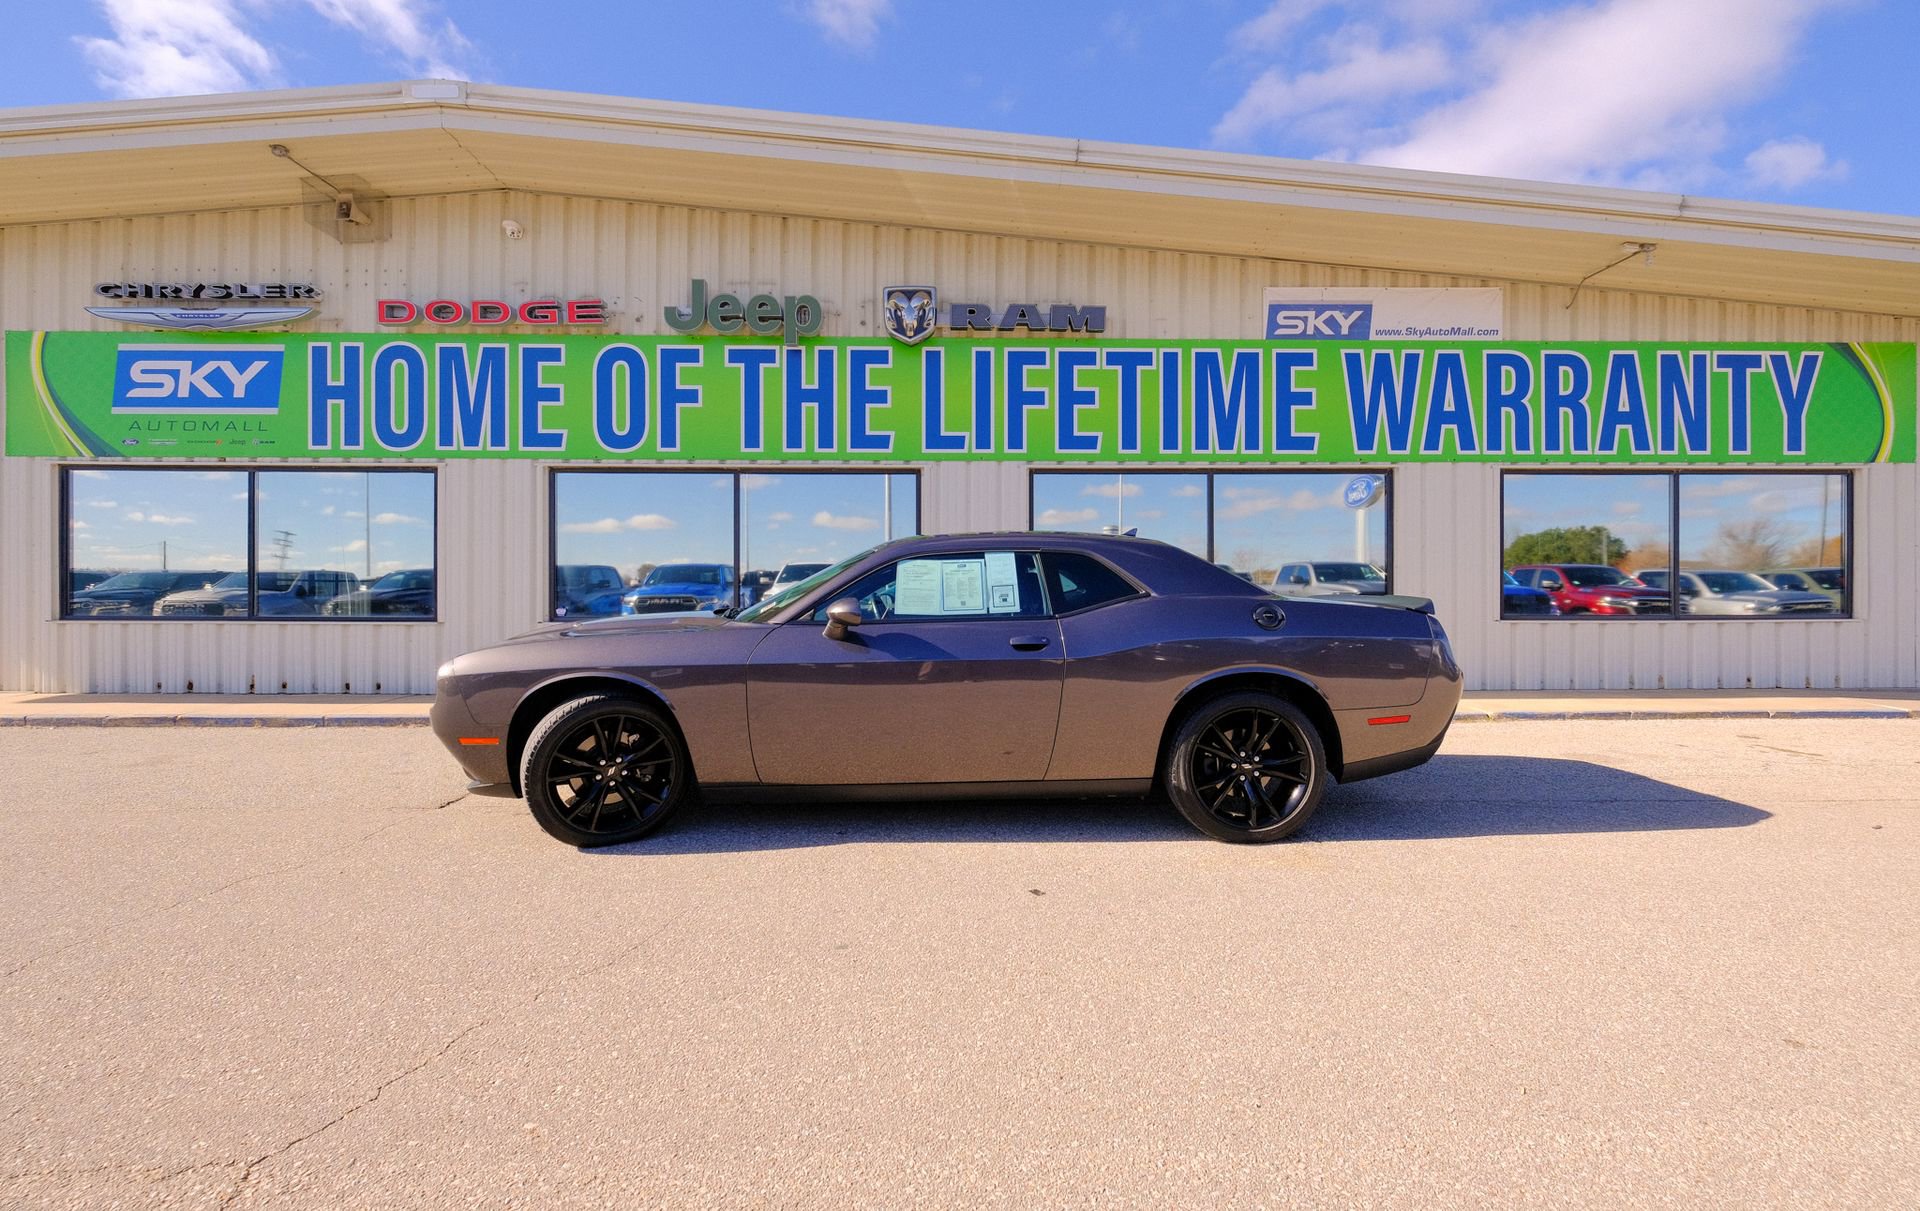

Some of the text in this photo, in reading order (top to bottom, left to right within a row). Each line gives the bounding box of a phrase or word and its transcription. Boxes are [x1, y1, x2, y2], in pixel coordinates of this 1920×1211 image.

[96, 283, 318, 299] CHRYSLER
[377, 300, 606, 325] DODGE
[664, 279, 822, 344] Jeep
[950, 303, 1107, 332] RAM
[1273, 310, 1363, 336] SKY
[1375, 327, 1499, 337] www.SkyAutoMall.com
[126, 360, 269, 398] SKY
[307, 341, 1825, 456] HOME OF THE LIFETIME WARRANTY
[128, 420, 269, 432] AUTOMALL
